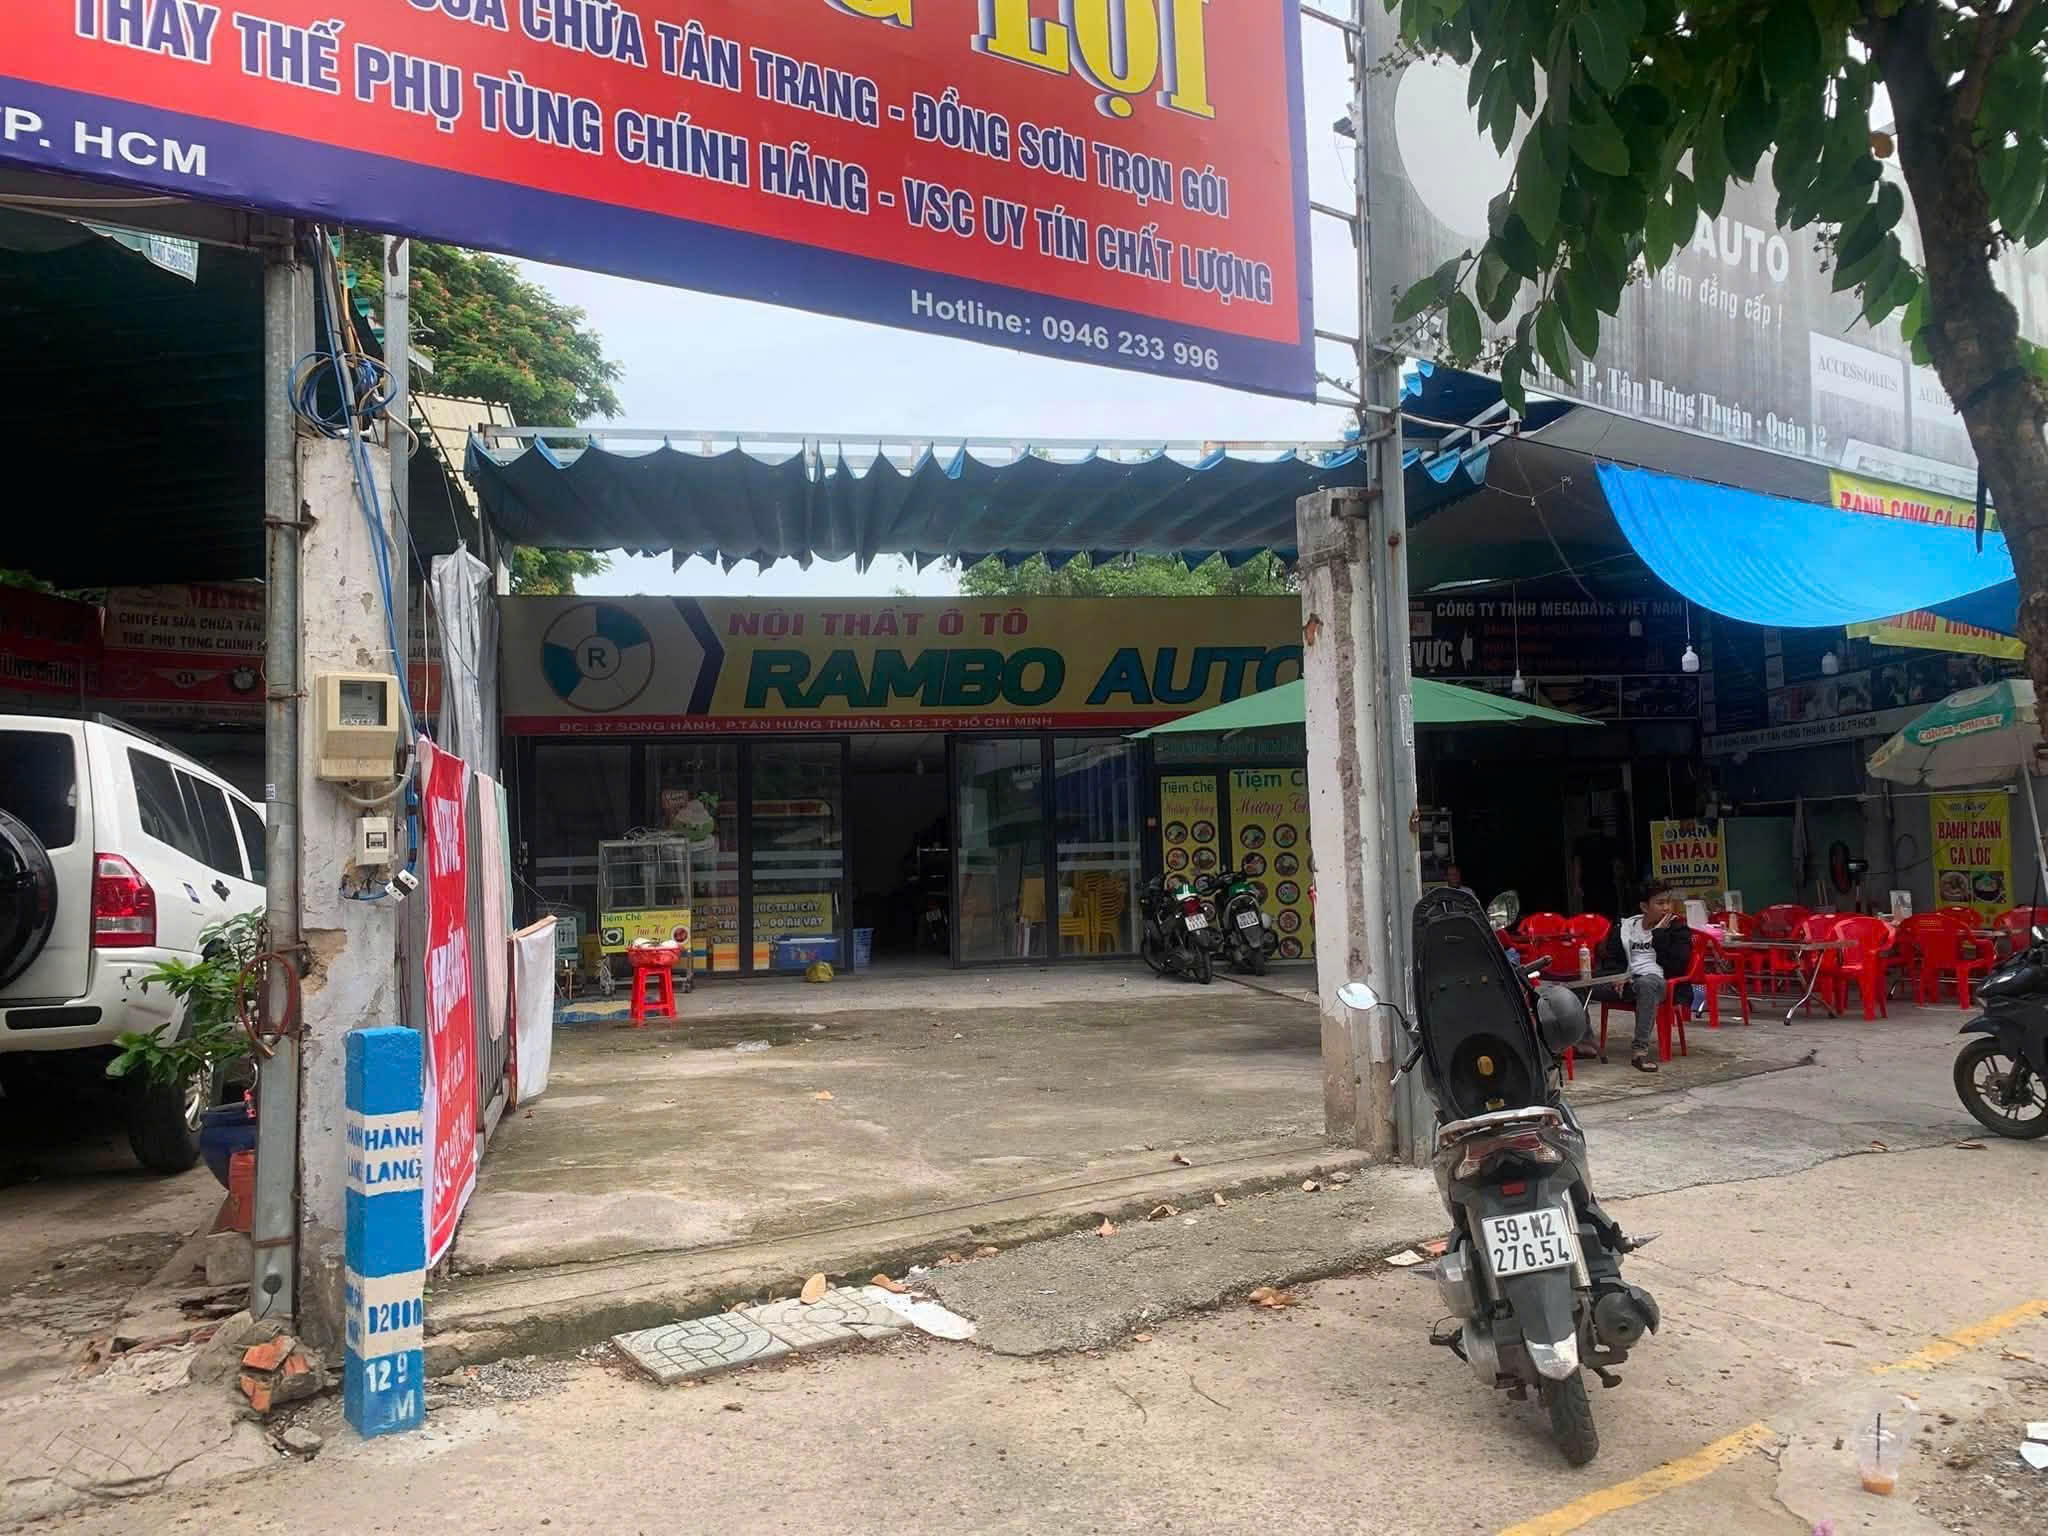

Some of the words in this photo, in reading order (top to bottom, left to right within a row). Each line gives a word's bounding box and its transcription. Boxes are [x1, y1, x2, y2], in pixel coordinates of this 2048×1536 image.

[656, 20, 742, 93] TÂN
[750, 47, 880, 128] TRANG
[913, 86, 1010, 161] ĐỒNG
[1018, 122, 1087, 181] SƠN
[1093, 141, 1174, 207] TRỌN
[1180, 164, 1230, 219] GÓI
[74, 121, 207, 177] HCM
[232, 20, 345, 94] THẾ
[354, 43, 462, 133] PHỤ
[474, 70, 603, 155] TÙNG
[616, 111, 750, 188] CHÍNH
[760, 141, 870, 216] HÃNG
[902, 176, 975, 237] VSC
[984, 196, 1027, 249] UY
[1035, 204, 1088, 264] TÍN
[1096, 223, 1173, 283] CHẤT
[1180, 244, 1273, 305] LƯỢNG
[1692, 209, 1789, 282] AUTO
[1744, 293, 1771, 329] cấp
[910, 289, 1032, 335] Hotline:
[1042, 316, 1109, 350] 0946
[1117, 331, 1165, 361] 233
[1173, 342, 1219, 371] 996
[1607, 367, 1644, 401] Tân
[1650, 379, 1695, 418] Hưng
[728, 608, 804, 640] NỘI
[821, 608, 924, 636] THẤT
[938, 609, 965, 636] Ô
[980, 608, 1028, 636] TÔ
[1480, 602, 1495, 617] TY
[743, 647, 1066, 709] RAMBO
[1233, 769, 1282, 792] Tiệm
[364, 1124, 423, 1151] HÀNH
[366, 1158, 422, 1185] LANG
[1494, 1213, 1556, 1243] 59-M2
[1493, 1238, 1570, 1273] 276.54
